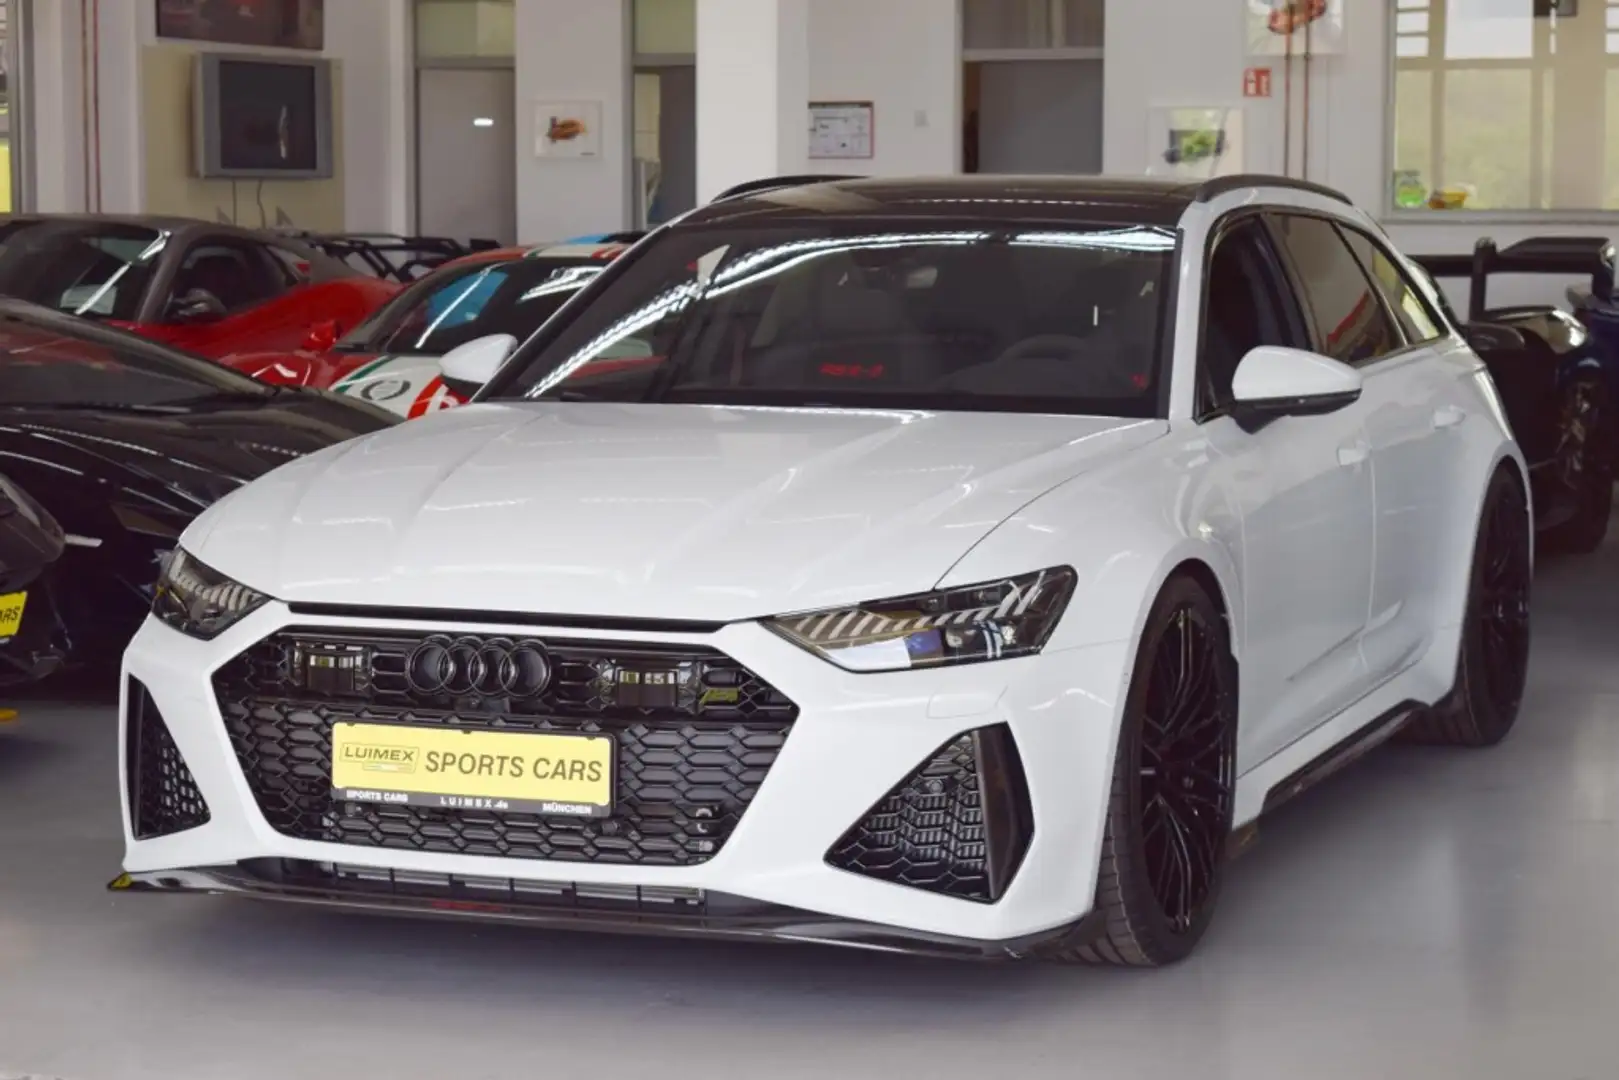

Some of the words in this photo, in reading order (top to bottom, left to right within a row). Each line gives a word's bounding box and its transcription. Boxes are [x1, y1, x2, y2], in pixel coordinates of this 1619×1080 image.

[344, 746, 414, 761] LUIMEX
[425, 750, 524, 778] SPORTS
[533, 757, 603, 782] CARS
[346, 789, 381, 801] SPORTS
[384, 792, 408, 803] CARS
[542, 802, 592, 814] MÜNCHEN
